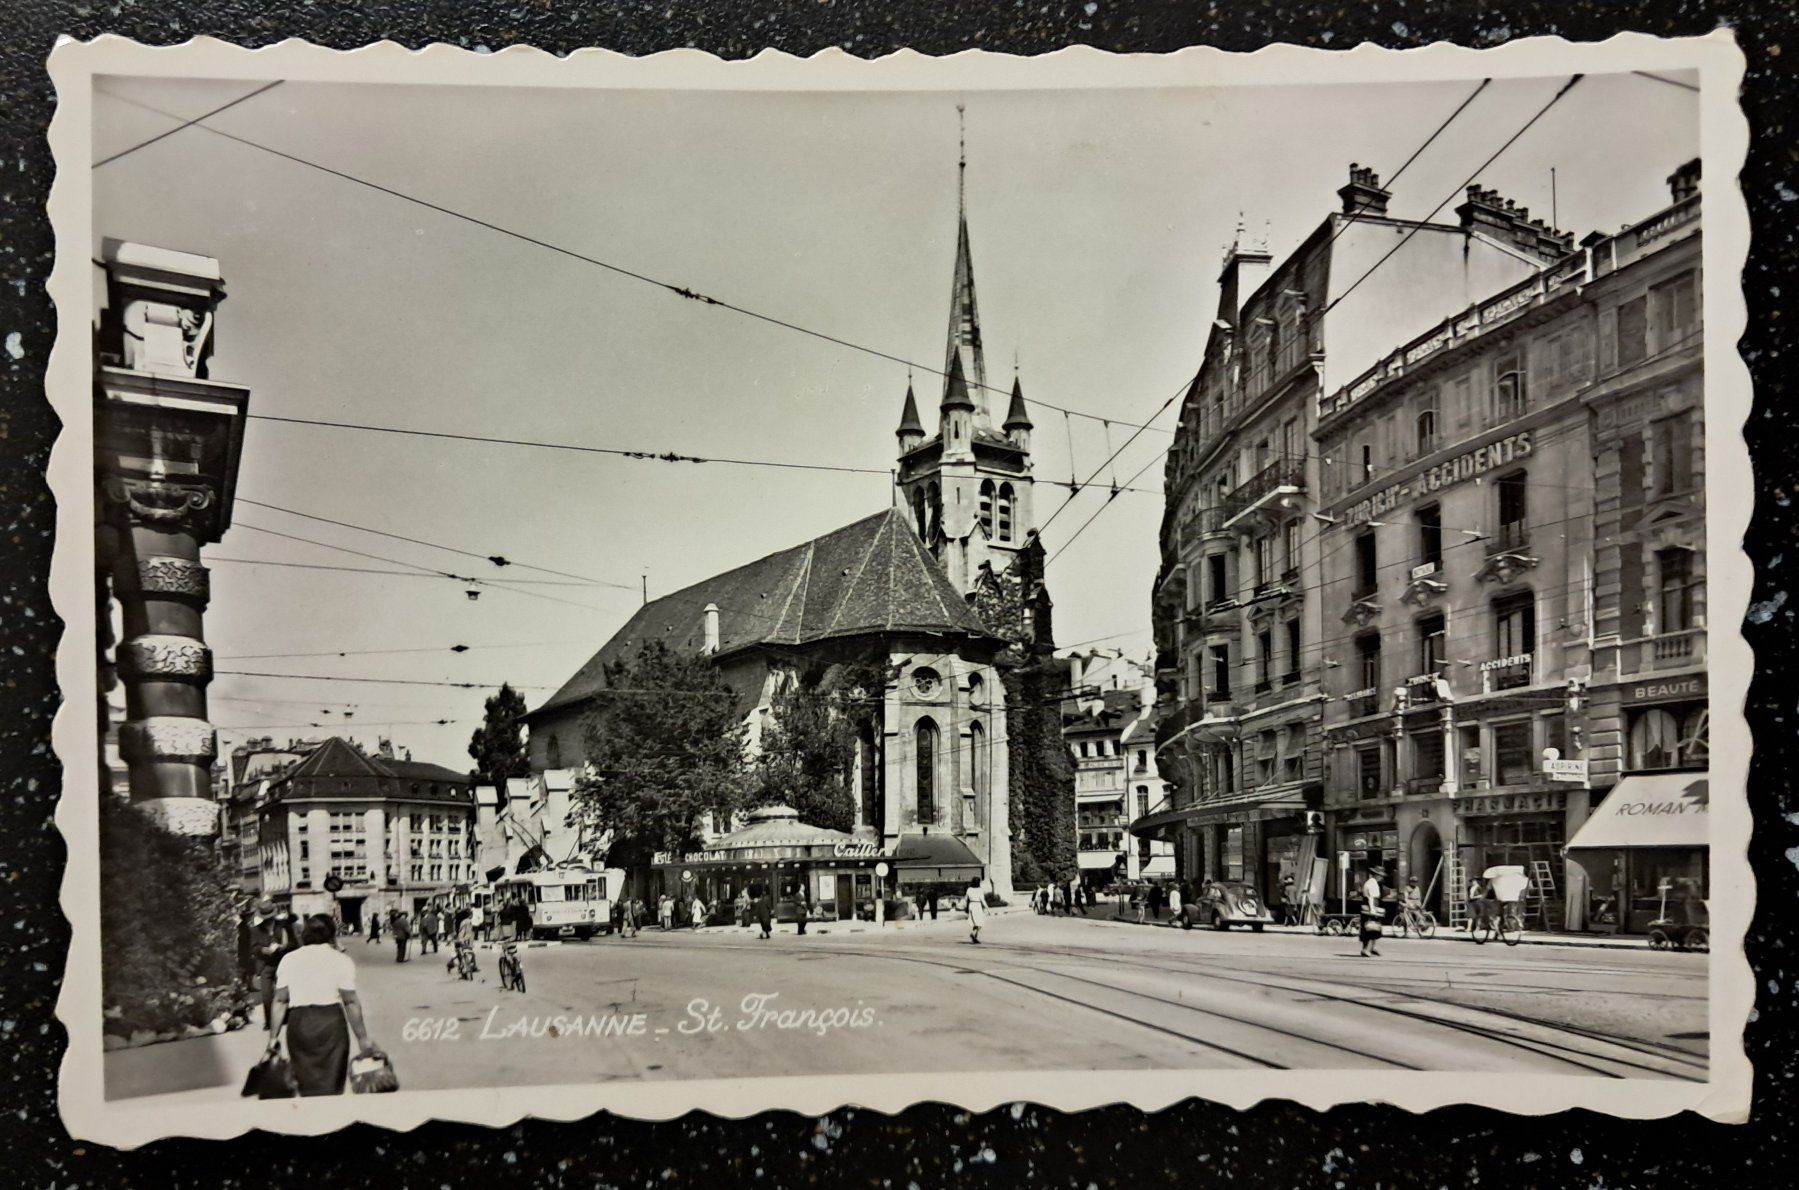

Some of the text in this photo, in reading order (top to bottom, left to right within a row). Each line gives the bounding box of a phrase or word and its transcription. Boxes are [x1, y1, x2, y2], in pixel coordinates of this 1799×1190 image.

[1480, 654, 1532, 672] ACCIDENTS
[1616, 802, 1690, 816] ROMAN
[685, 850, 726, 862] CHOCOLAT
